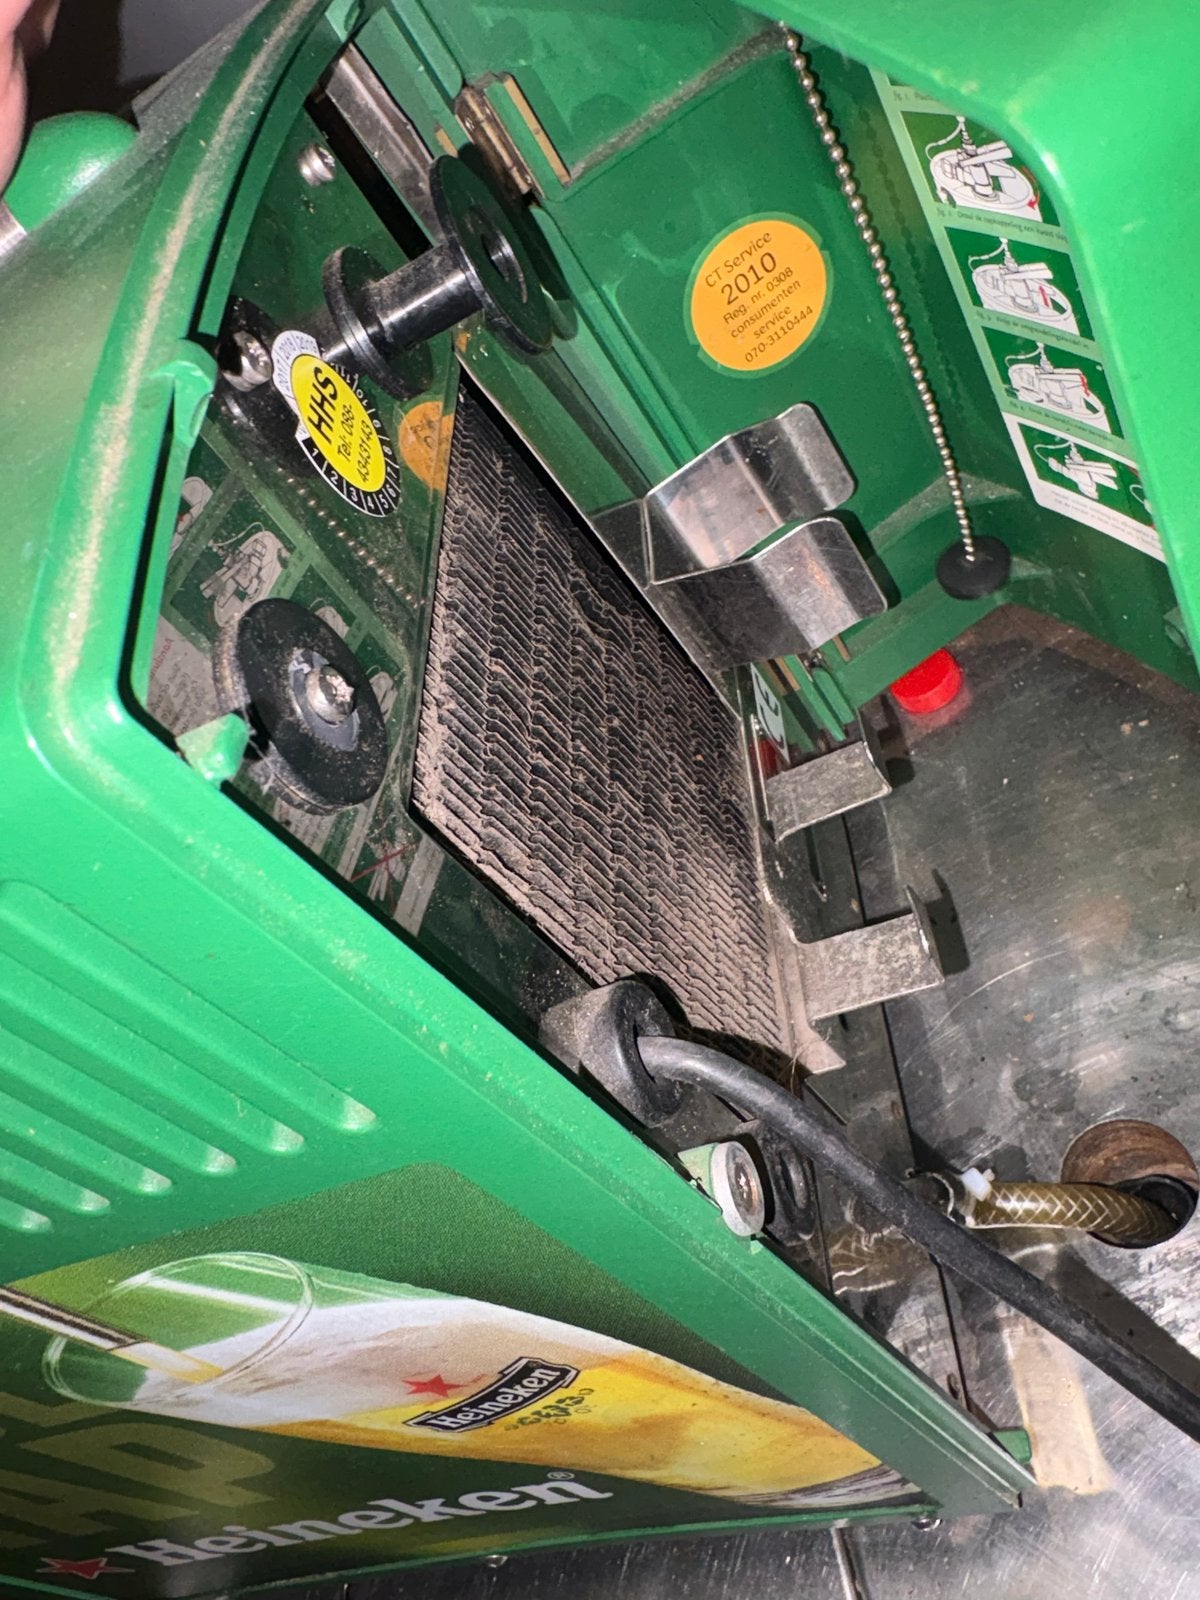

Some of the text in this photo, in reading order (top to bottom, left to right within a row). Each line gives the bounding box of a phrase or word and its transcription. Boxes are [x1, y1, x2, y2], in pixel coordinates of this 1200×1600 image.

[704, 231, 773, 288] CT Service
[720, 251, 778, 306] 2010
[722, 266, 794, 325] Reg. nr. 0308
[730, 279, 802, 339] consumenten
[744, 305, 814, 363] 070-3110444
[753, 304, 793, 339] service
[307, 366, 338, 446] HHS
[312, 447, 319, 457] 1
[336, 435, 352, 463] Tel:
[355, 420, 374, 483] 4343143
[382, 444, 393, 456] 8
[330, 470, 340, 485] 2
[387, 468, 398, 479] 7
[349, 487, 359, 502] 3
[366, 493, 375, 508] 4
[380, 493, 389, 509] 5
[387, 484, 397, 498] 6
[426, 1367, 562, 1430] Heineken
